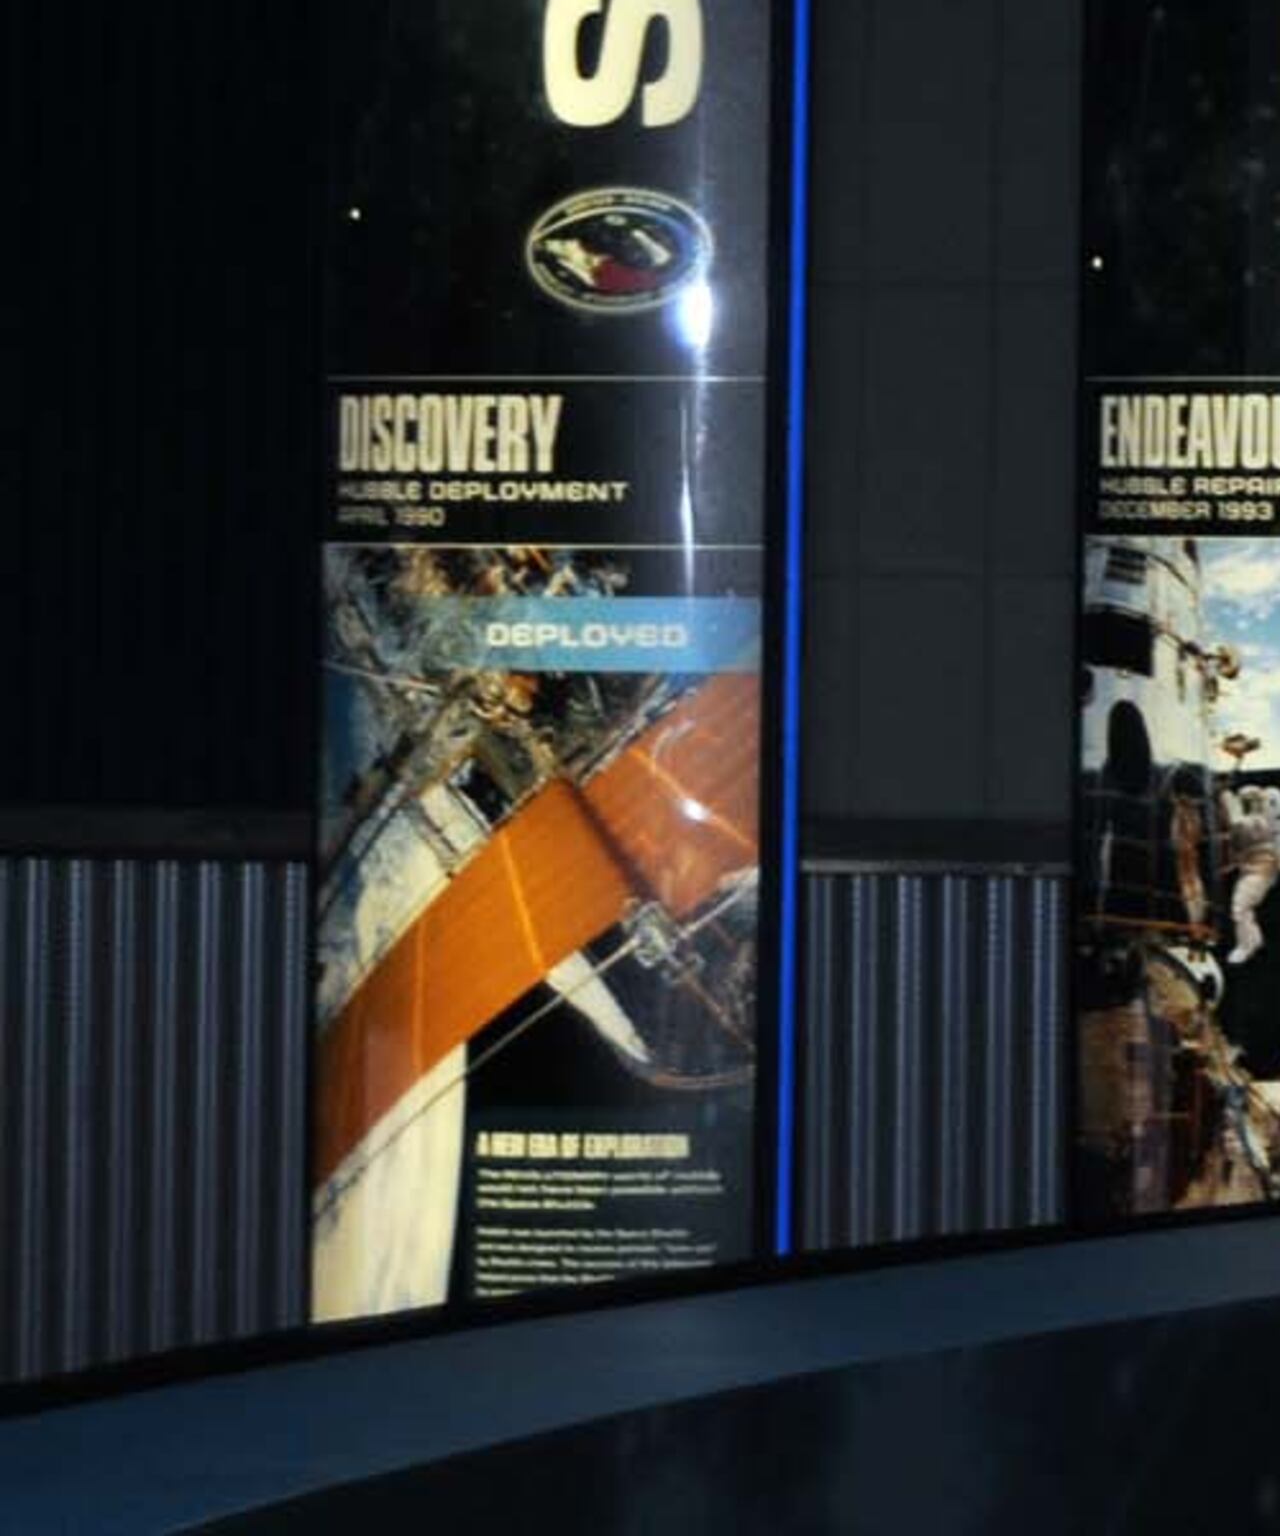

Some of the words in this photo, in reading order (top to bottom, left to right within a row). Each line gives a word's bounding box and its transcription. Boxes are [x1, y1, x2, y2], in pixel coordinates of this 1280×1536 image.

[339, 394, 562, 473] DISCOVERY
[429, 481, 630, 502] DEPLOYMENT
[1100, 477, 1186, 495] HUBBLE
[394, 506, 445, 526] 1990
[1101, 502, 1211, 518] DECEMBER
[1218, 501, 1274, 520] 1993
[486, 624, 688, 648] DEPLOYED
